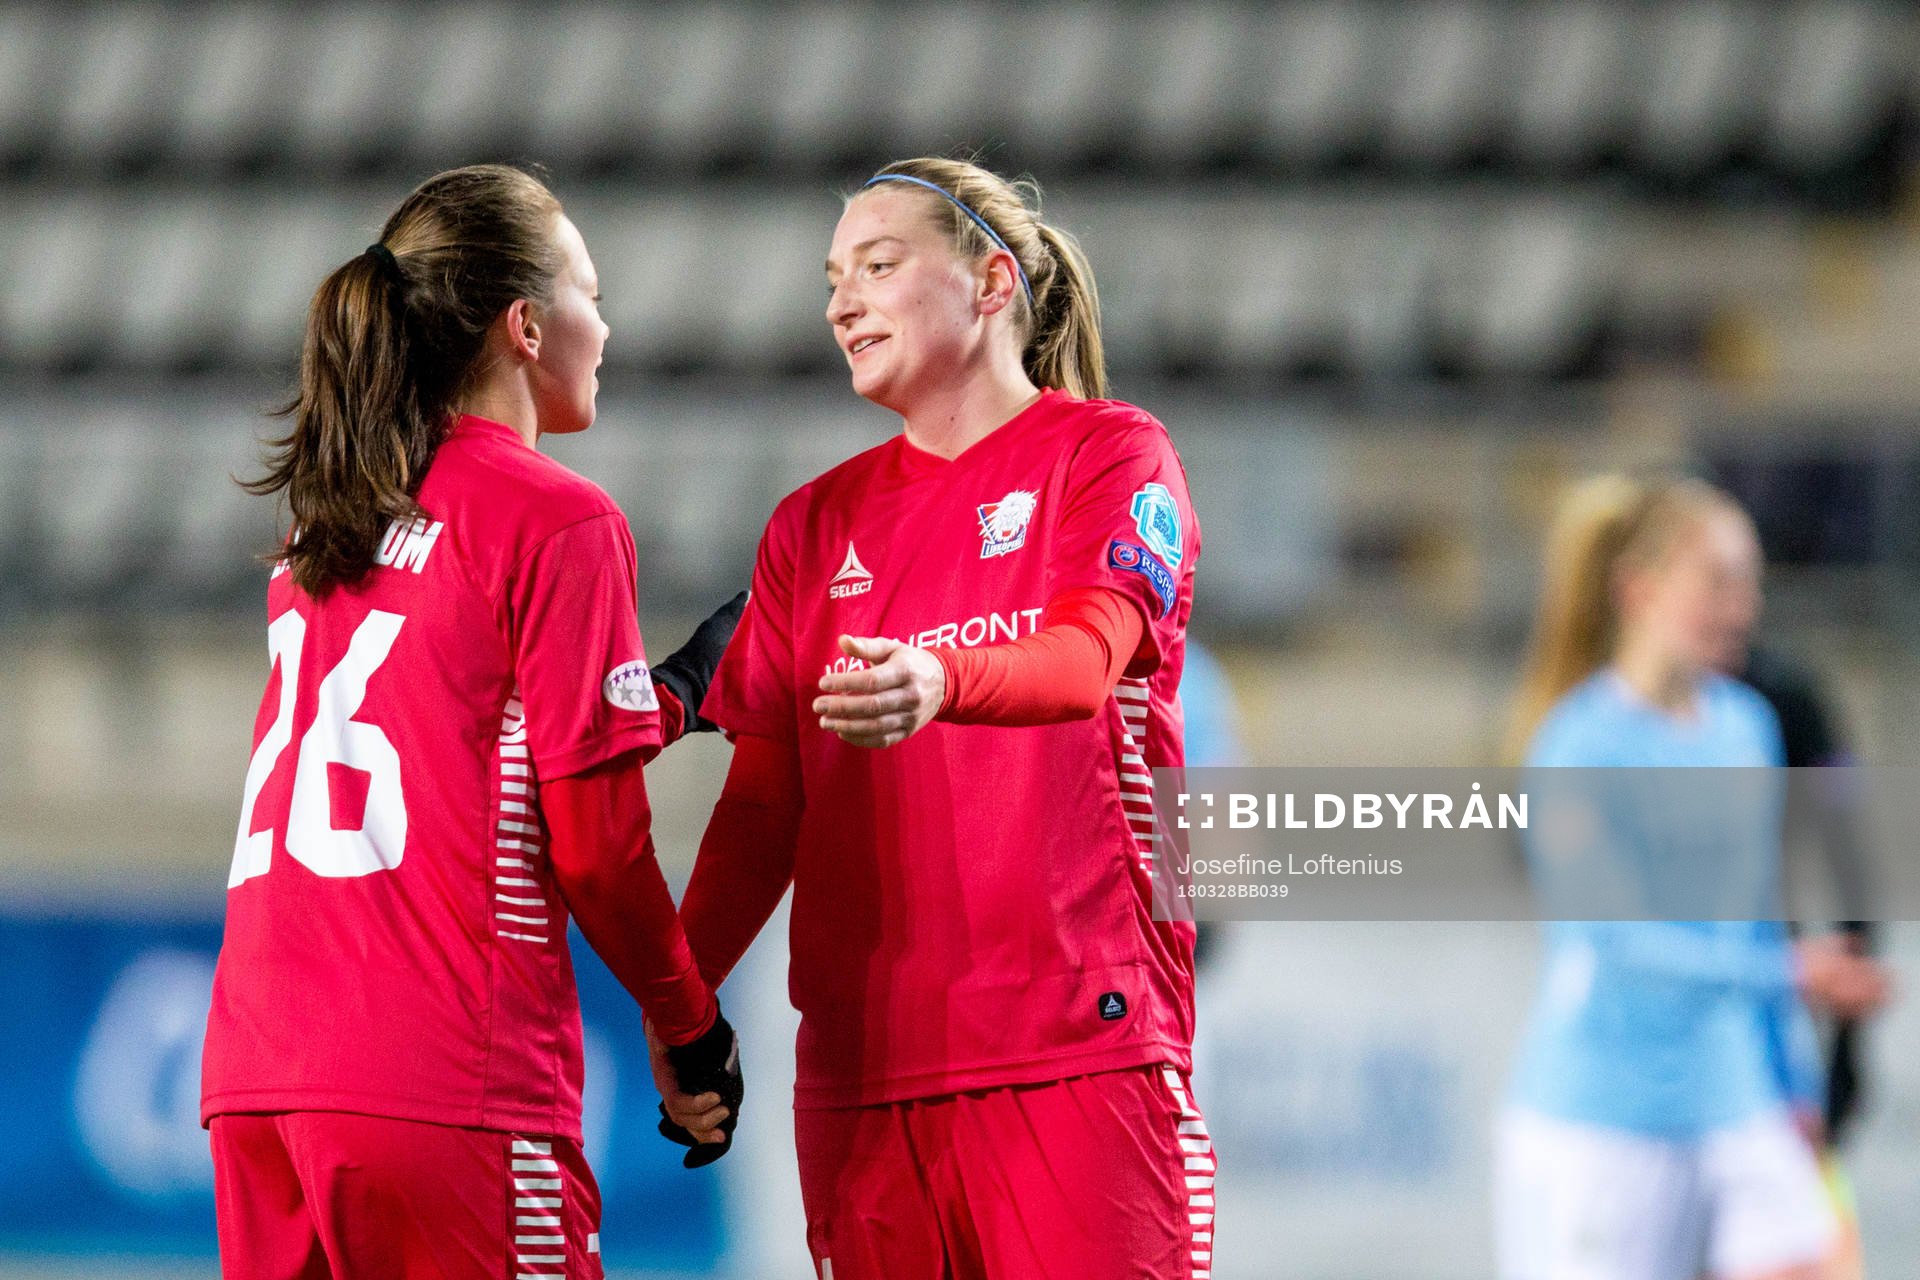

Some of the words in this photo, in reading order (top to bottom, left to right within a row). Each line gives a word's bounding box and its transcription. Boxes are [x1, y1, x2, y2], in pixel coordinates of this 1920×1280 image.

[829, 579, 873, 599] SELECT
[1142, 555, 1174, 608] RESPEC
[227, 608, 408, 890] 26
